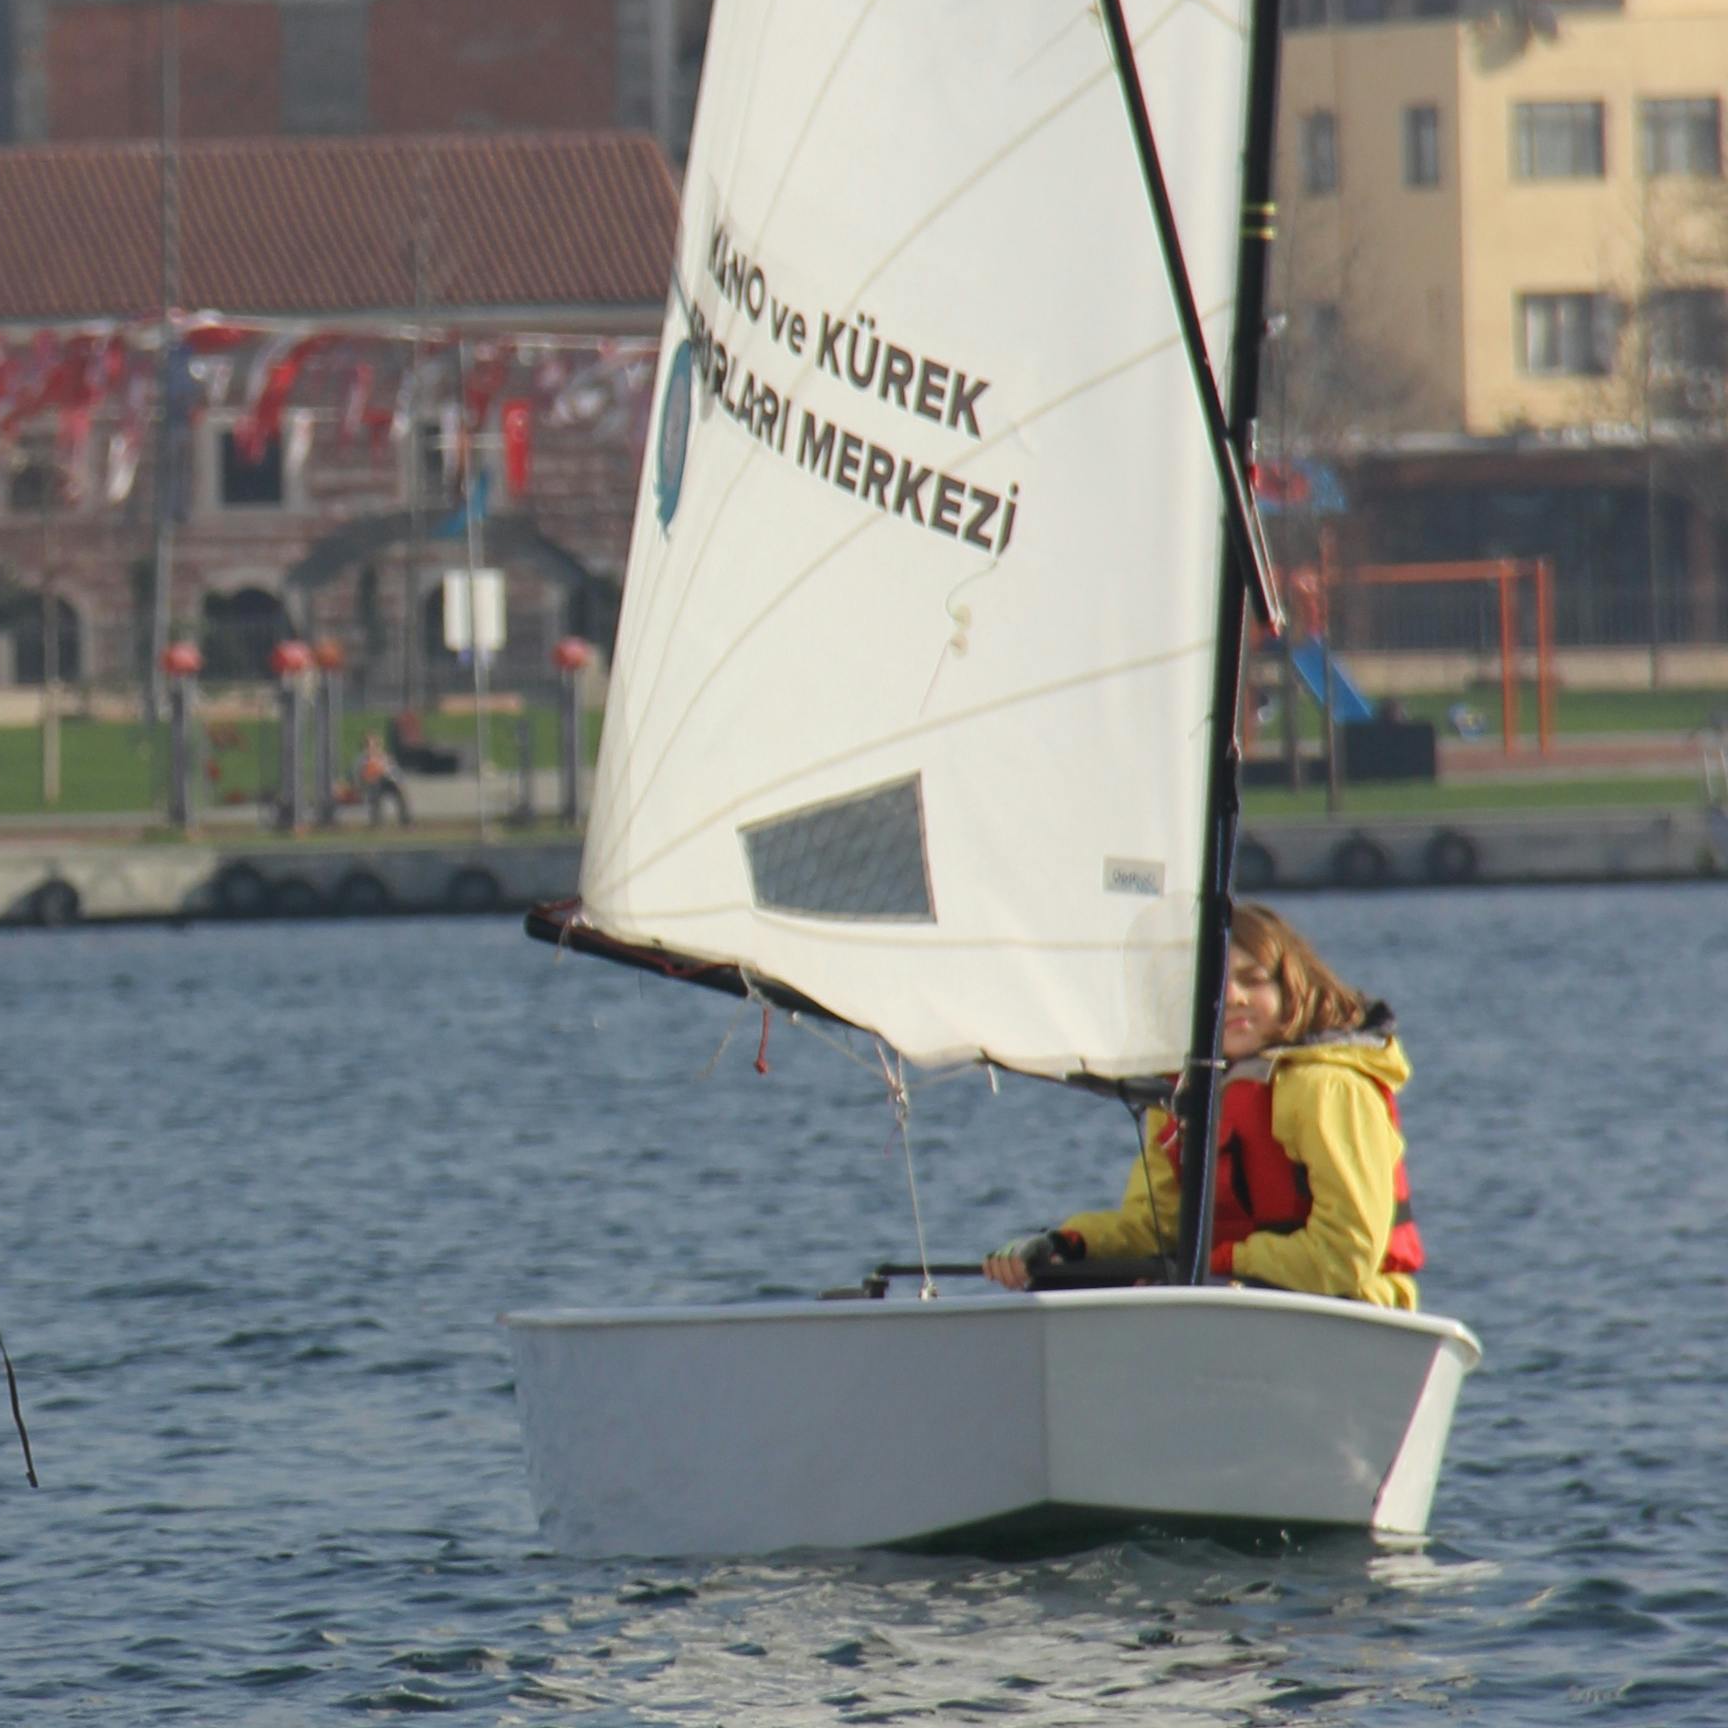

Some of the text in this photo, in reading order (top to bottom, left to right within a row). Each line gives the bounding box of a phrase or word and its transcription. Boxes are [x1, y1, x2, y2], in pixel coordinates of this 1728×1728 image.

[771, 295, 806, 354] ve
[815, 311, 990, 440] KÜREK
[795, 407, 1019, 556] MERKEZİ
